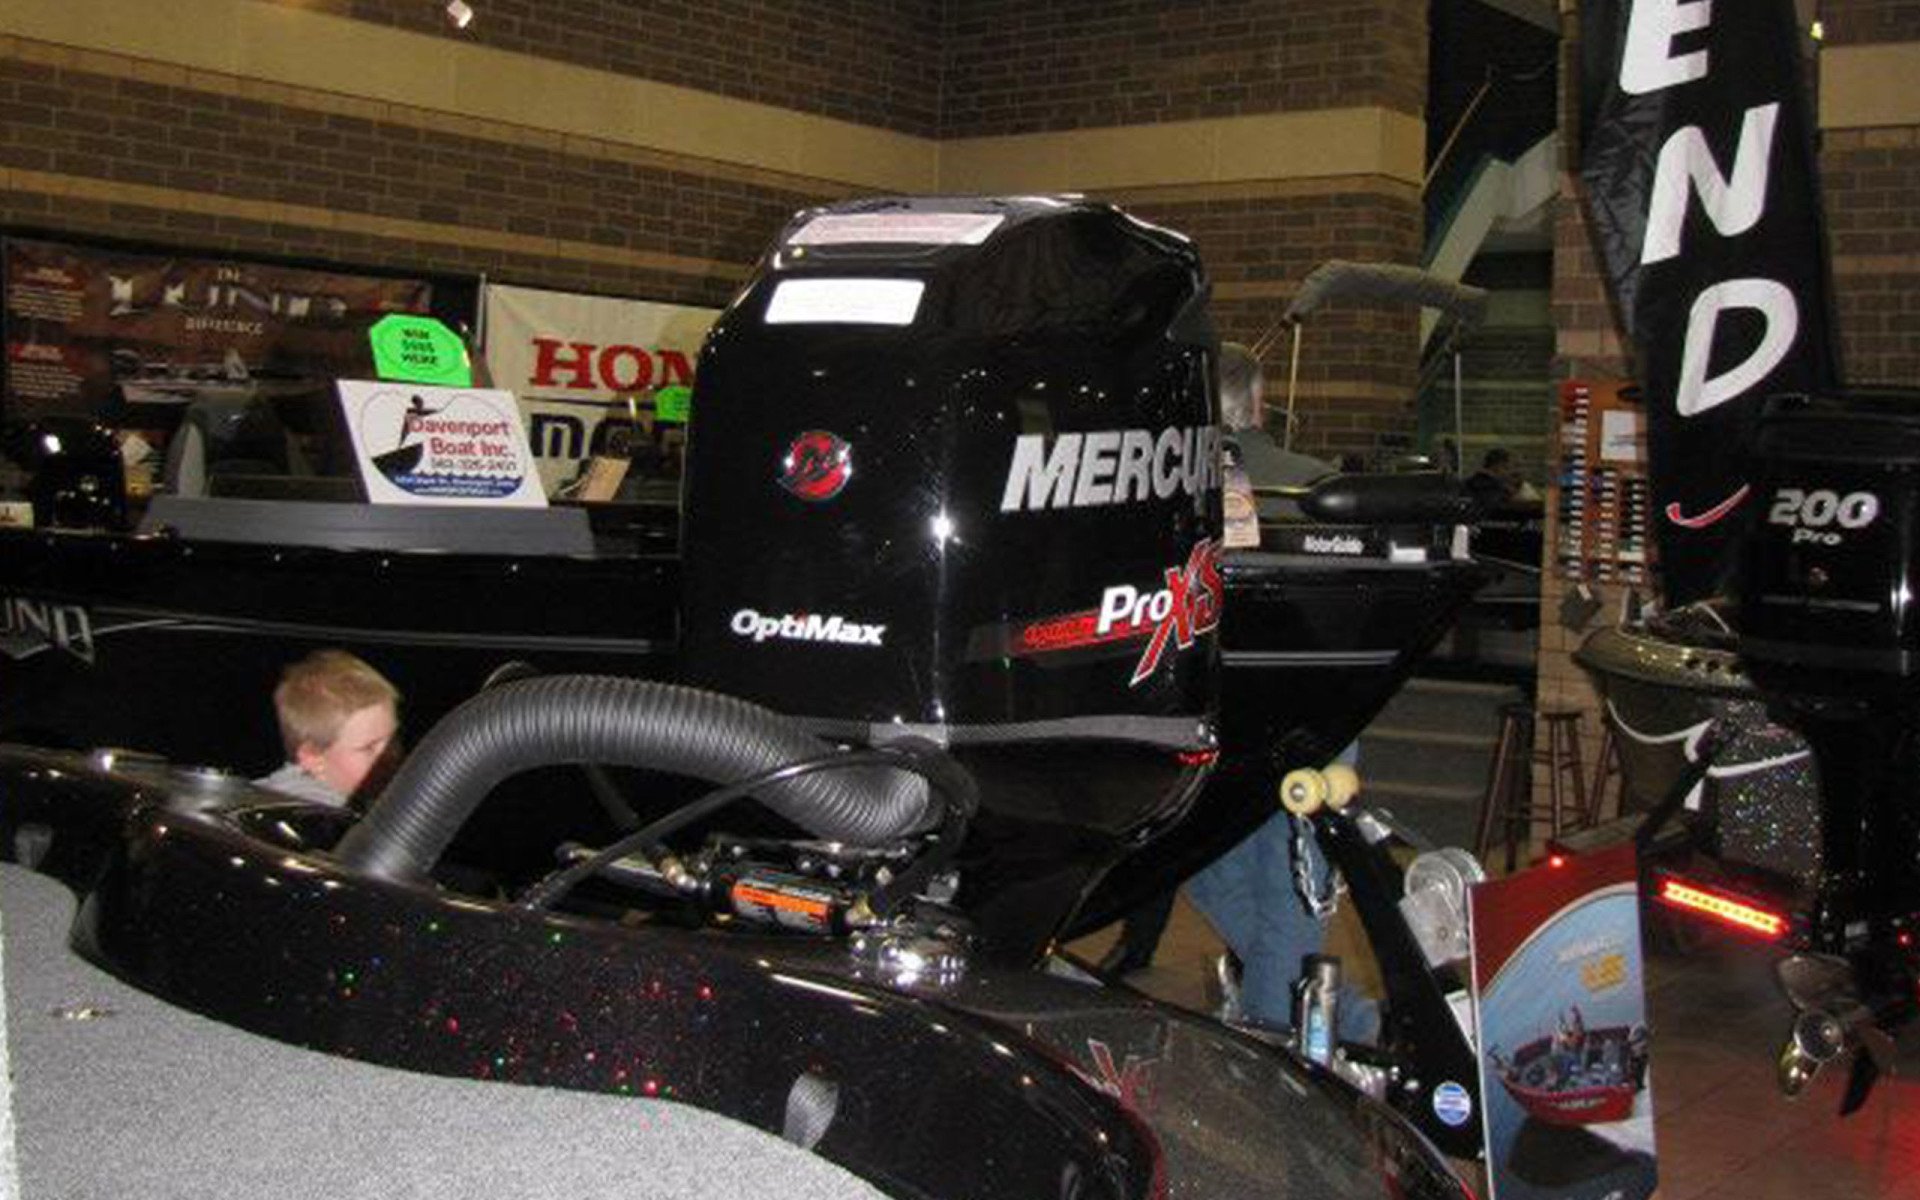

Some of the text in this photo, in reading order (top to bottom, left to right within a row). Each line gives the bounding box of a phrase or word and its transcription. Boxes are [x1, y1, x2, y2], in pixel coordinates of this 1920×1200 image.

[529, 337, 697, 392] HON
[407, 419, 510, 438] Davenport
[431, 437, 477, 456] Boat
[1000, 425, 1219, 513] MERCUR
[1768, 488, 1879, 529] 200
[1792, 527, 1842, 545] Pro
[730, 608, 887, 646] OptiMax
